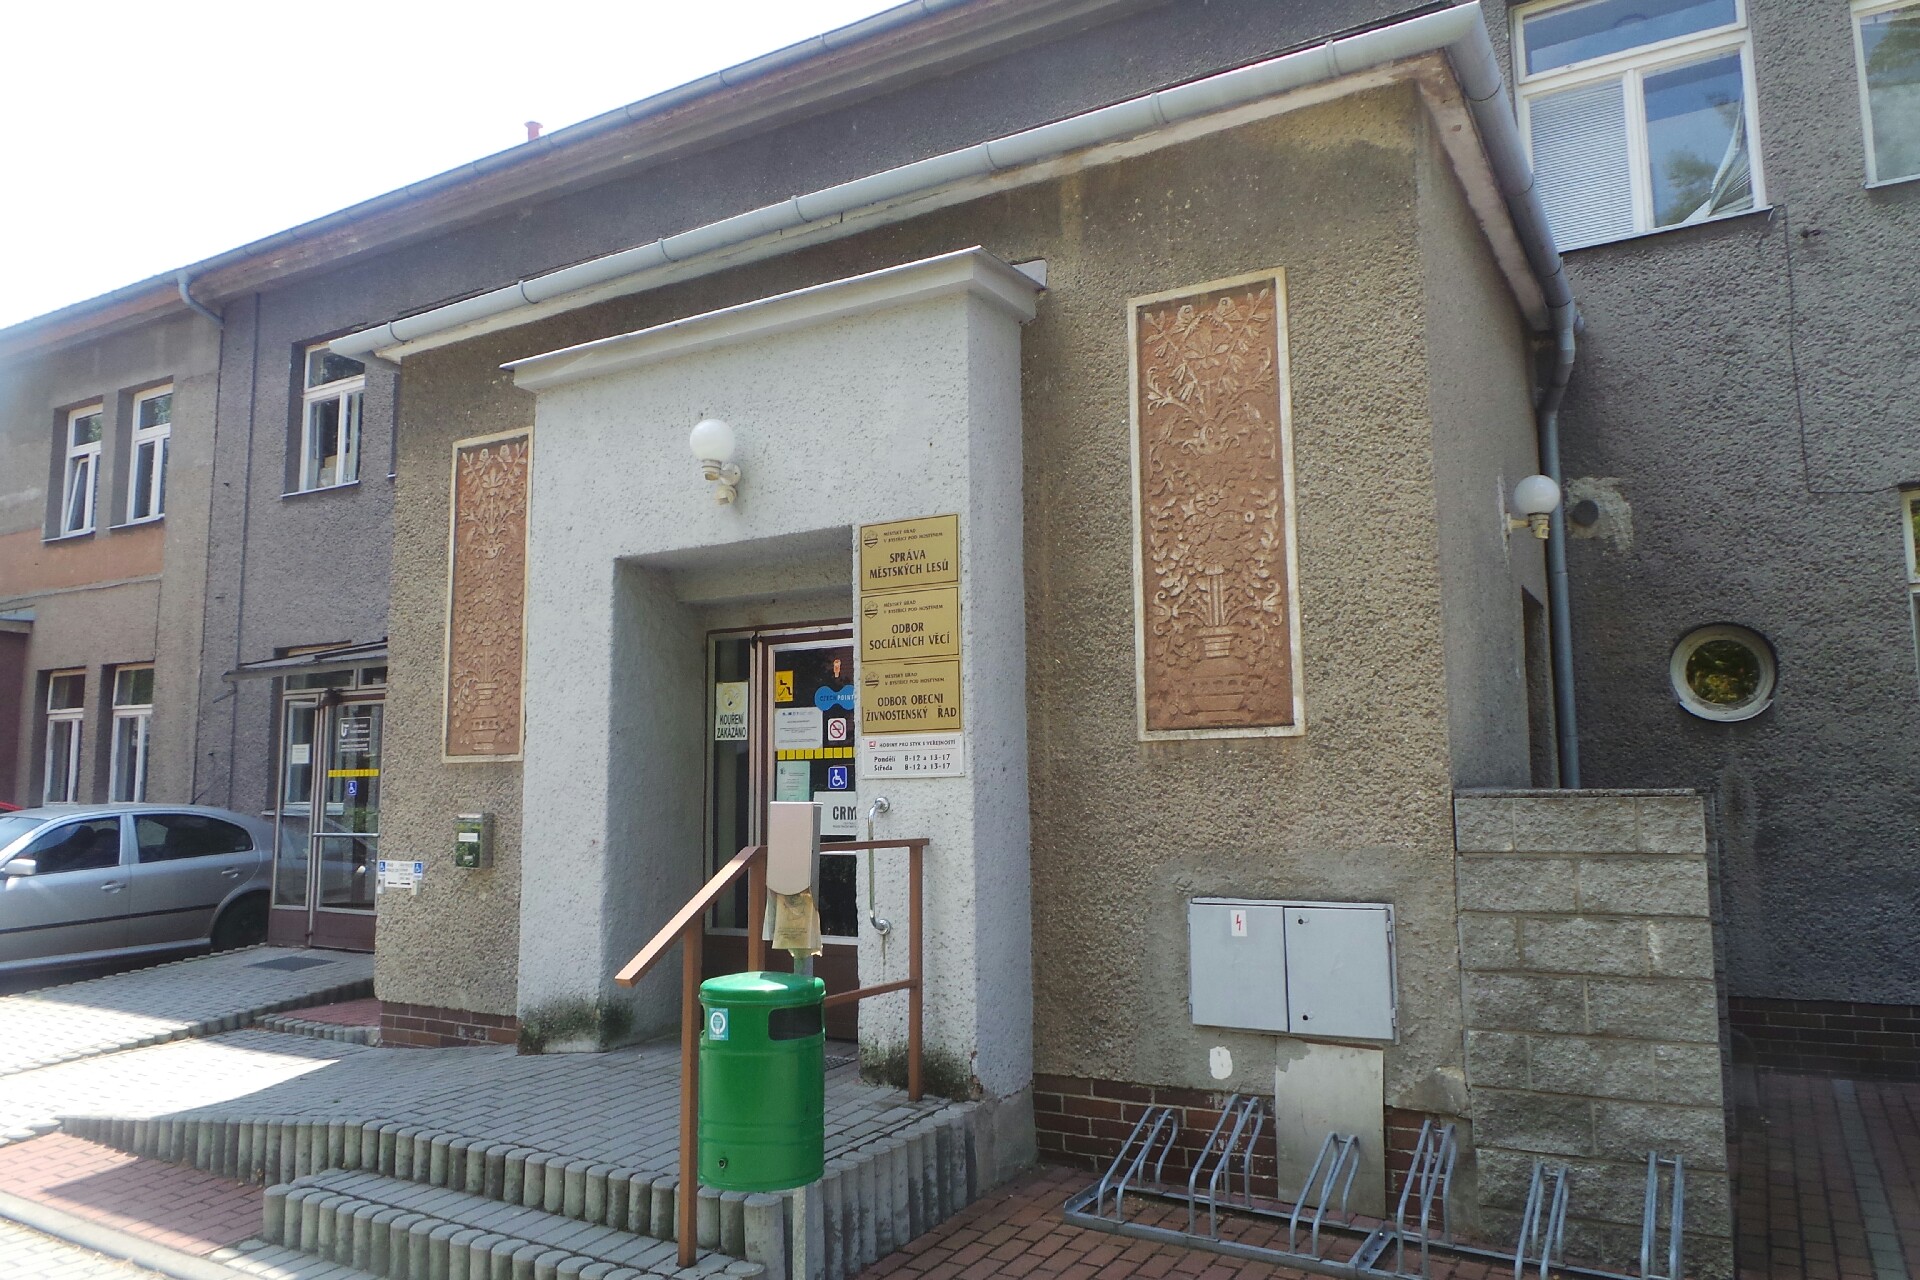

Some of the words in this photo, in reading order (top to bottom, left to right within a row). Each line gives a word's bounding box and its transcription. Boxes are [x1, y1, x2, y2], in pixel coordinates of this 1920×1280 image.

[890, 549, 926, 563] SPRÁVA
[869, 563, 922, 579] MĚSTSKÝCH
[892, 622, 924, 634] ODBOR
[870, 634, 924, 650] SOCIÁLNÍCH
[928, 631, 950, 645] VĚCÍ
[877, 696, 907, 707] ODBOR
[720, 712, 744, 725] KOUŘENÍ
[866, 706, 928, 722] ŽIVNOSTENSKÝ
[938, 706, 956, 718] ŘAD
